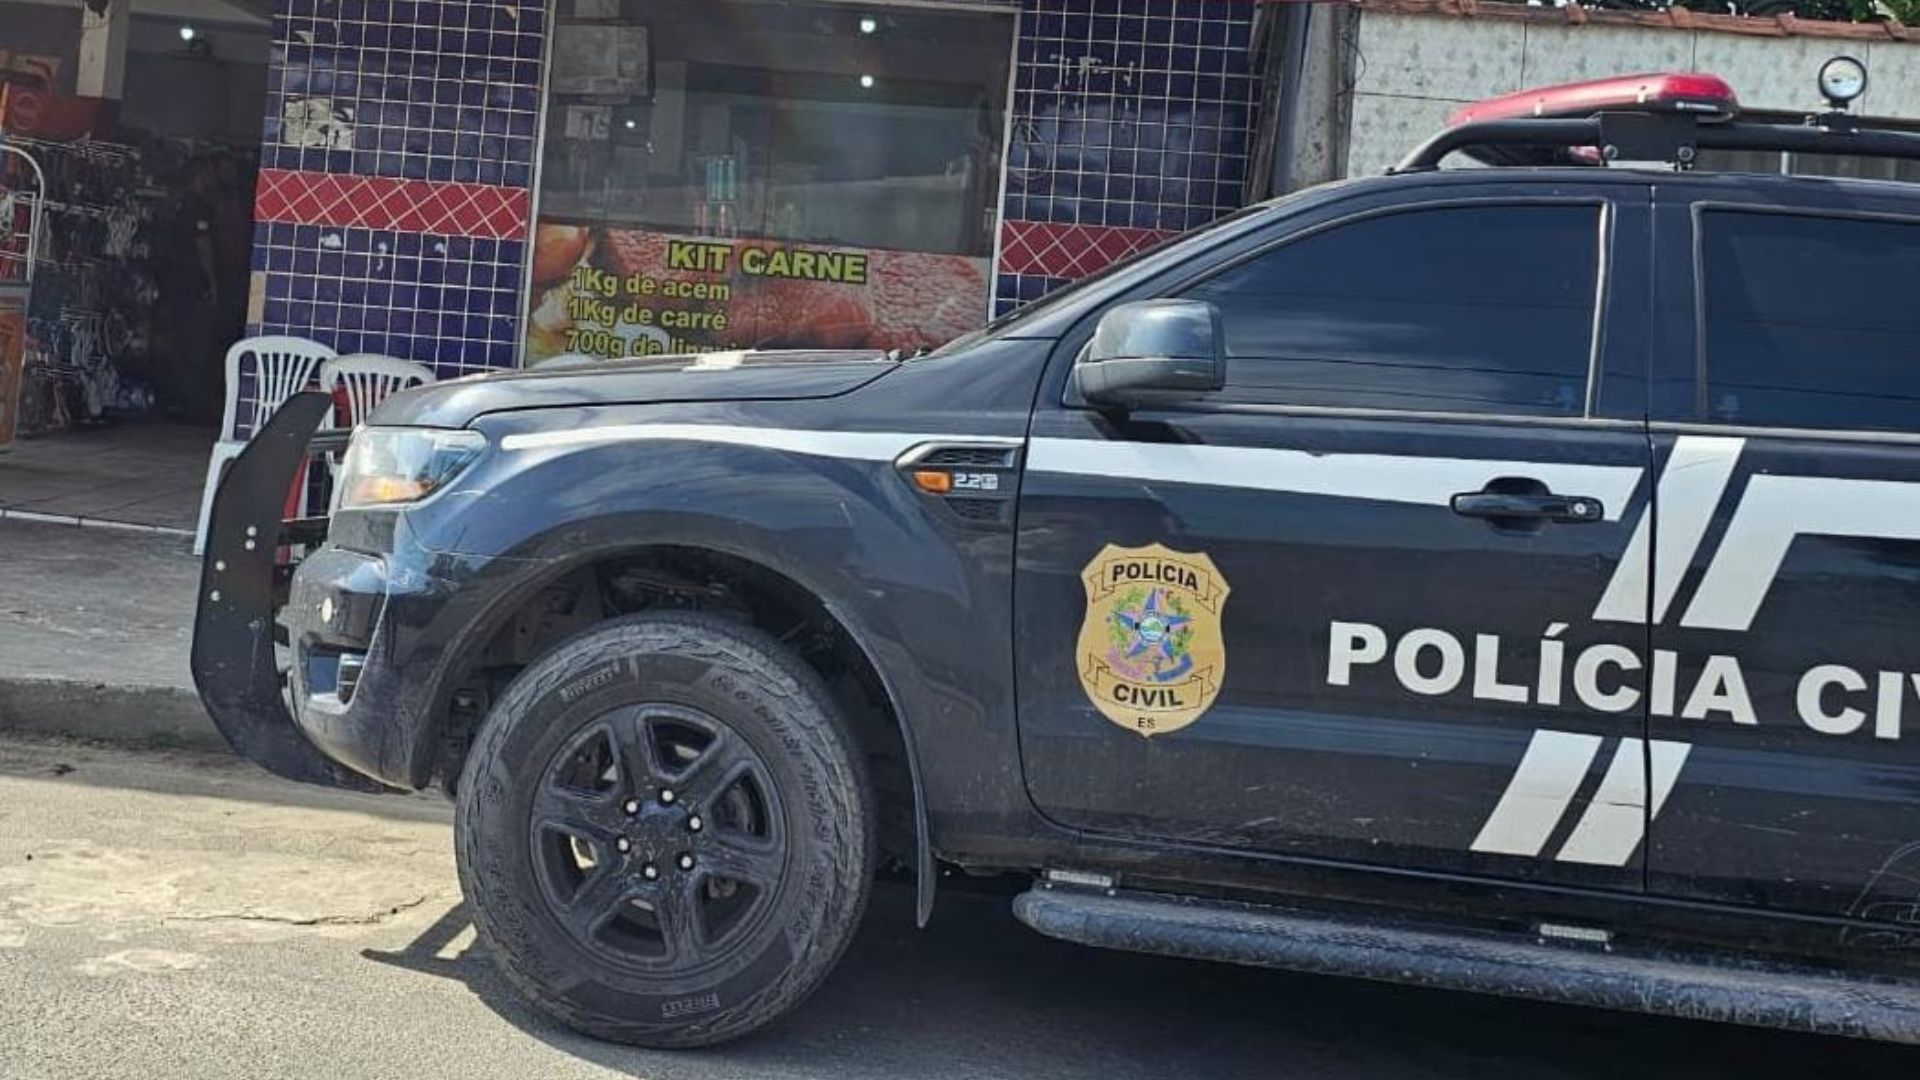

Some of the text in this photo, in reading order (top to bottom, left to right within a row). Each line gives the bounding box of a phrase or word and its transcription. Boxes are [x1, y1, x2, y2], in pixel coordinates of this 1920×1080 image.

[670, 241, 867, 284] KIT CARNE
[572, 267, 618, 297] 1Kg
[625, 273, 655, 295] de
[567, 297, 727, 330] 1Kg de carré
[564, 330, 624, 358] 700g
[632, 334, 663, 356] de
[1112, 560, 1198, 590] POLÍCIA
[1327, 621, 1920, 739] POLÍCIA CI
[1112, 684, 1184, 708] CIVIL
[1138, 717, 1156, 729] ES
